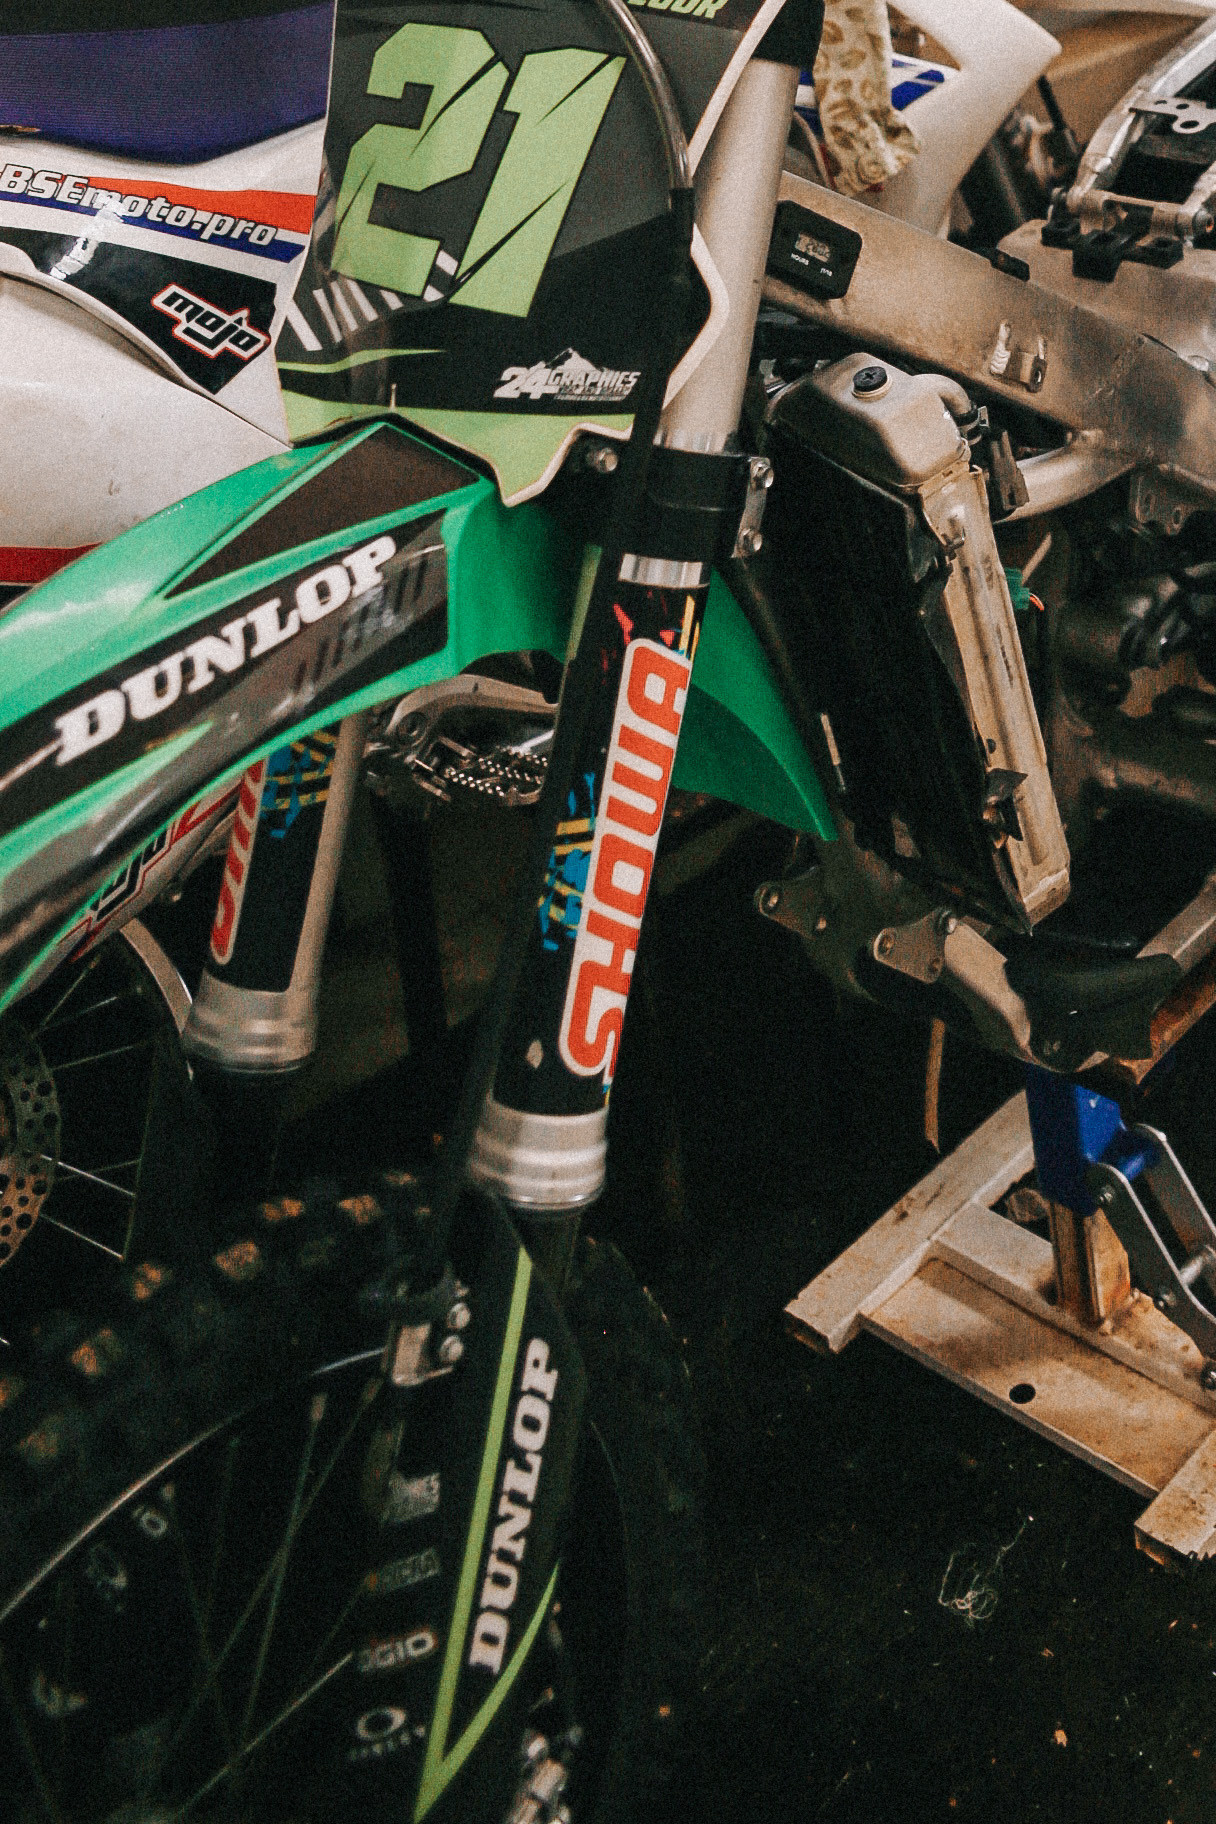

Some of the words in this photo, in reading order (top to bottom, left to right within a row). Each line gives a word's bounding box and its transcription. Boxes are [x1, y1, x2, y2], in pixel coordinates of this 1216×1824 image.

[330, 22, 628, 318] 21
[161, 290, 262, 353] mojo
[493, 361, 560, 400] 24
[550, 367, 642, 389] GRAPHICS
[55, 535, 397, 767] DUNLOP
[566, 645, 691, 1078] SHOWA
[469, 1337, 558, 1676] DUNLOP
